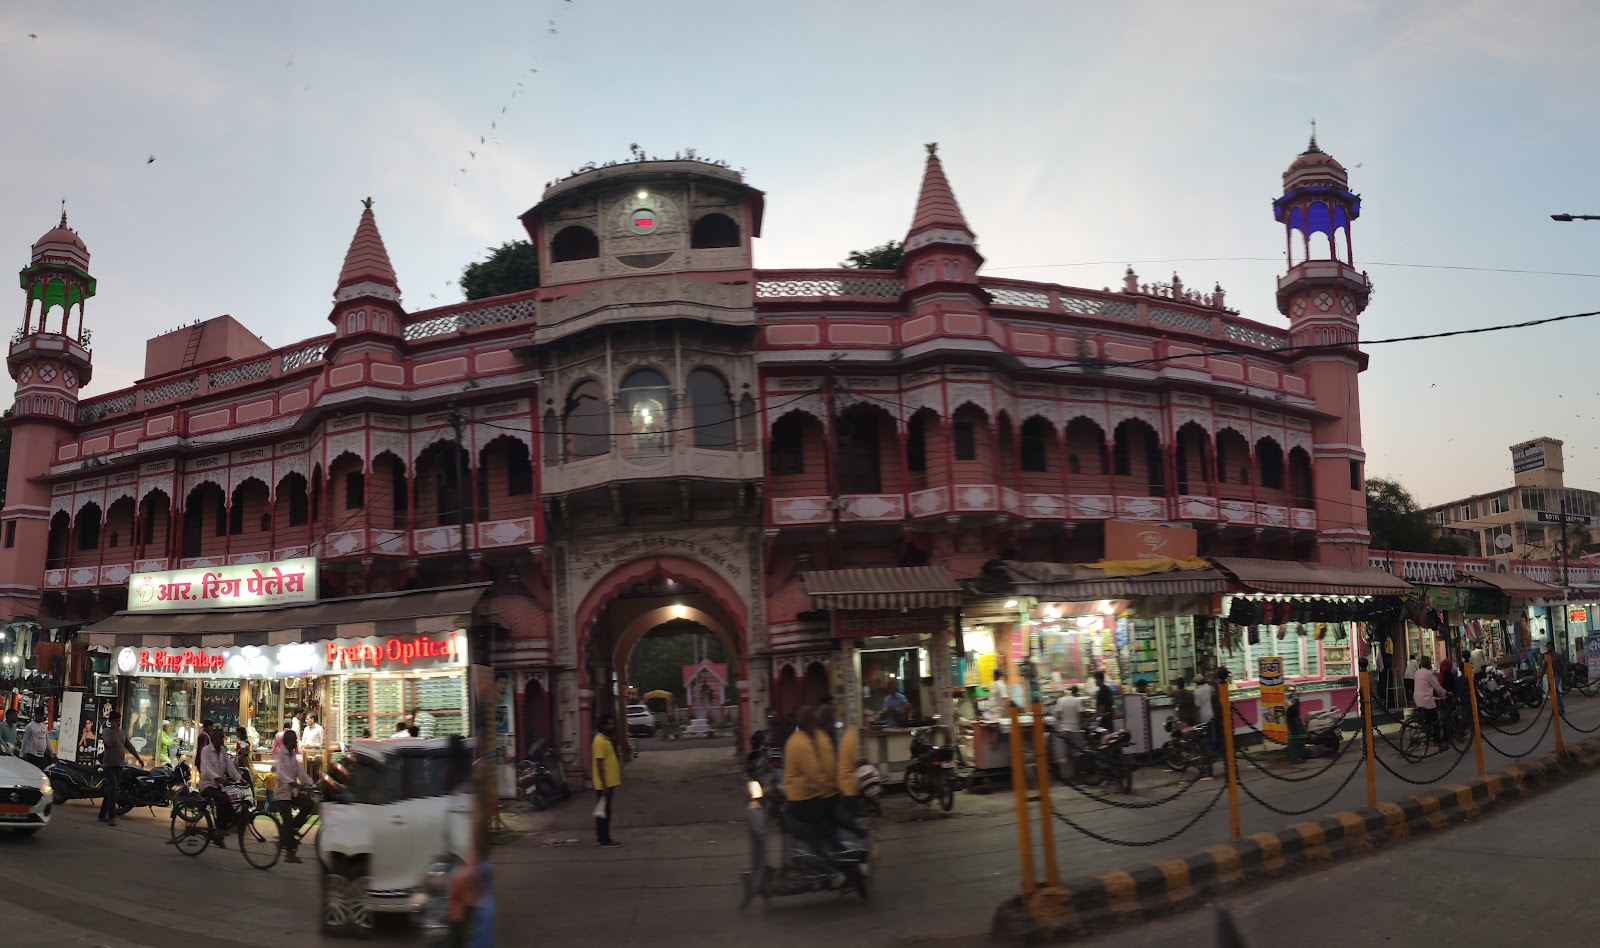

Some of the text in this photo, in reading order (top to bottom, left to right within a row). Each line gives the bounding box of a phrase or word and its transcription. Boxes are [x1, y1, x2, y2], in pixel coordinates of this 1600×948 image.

[157, 567, 305, 601] आर. रिंग पेलेस
[154, 650, 183, 671] Ring
[183, 650, 225, 668] Palace
[326, 632, 459, 666] Pratap Optical
